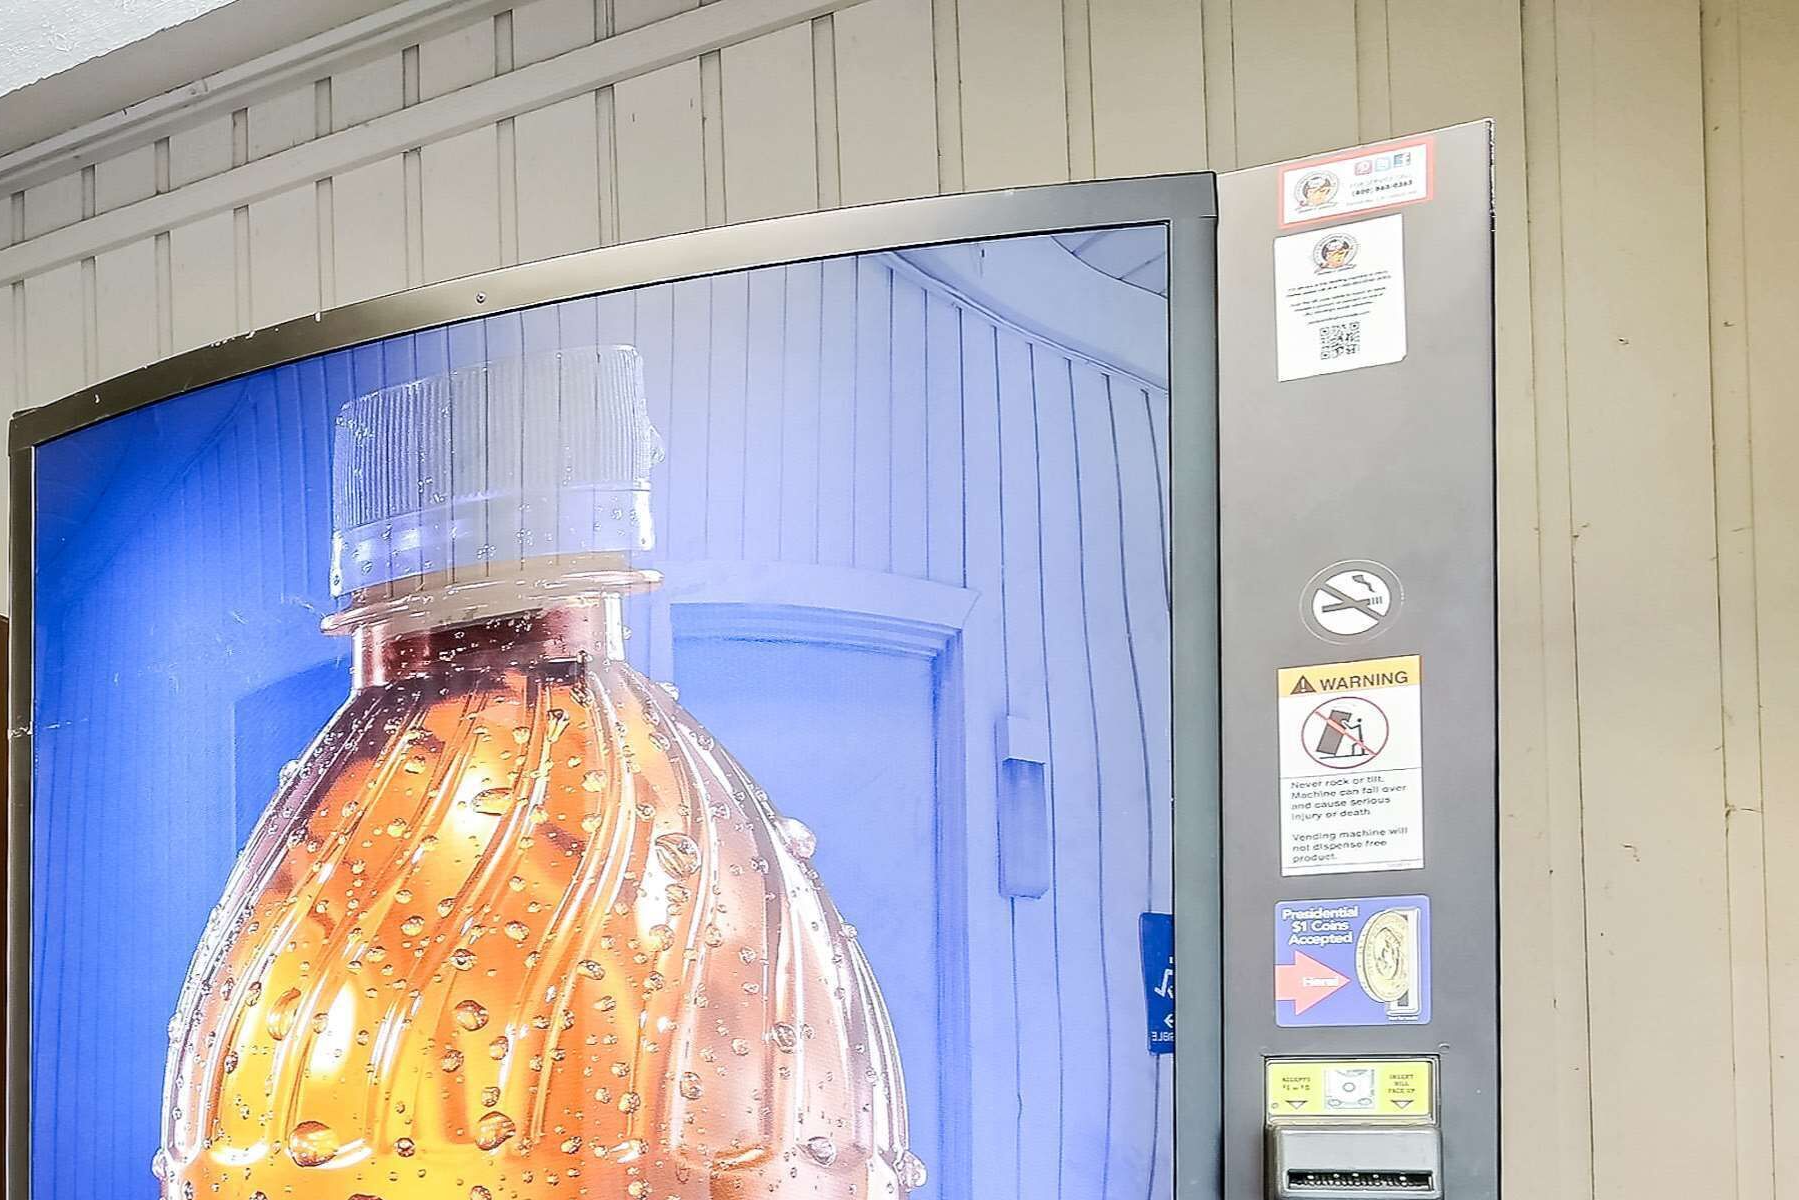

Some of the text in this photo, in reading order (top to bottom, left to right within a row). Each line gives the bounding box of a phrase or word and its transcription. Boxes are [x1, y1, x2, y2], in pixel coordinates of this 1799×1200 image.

[1320, 671, 1408, 691] WARNING
[1290, 781, 1322, 789] Never
[1325, 778, 1349, 786] rock
[1291, 791, 1336, 799] Machine
[1362, 786, 1379, 794] fall
[1381, 785, 1407, 793] over
[1291, 797, 1391, 810] and cause serious
[1292, 832, 1336, 841] Vending
[1339, 830, 1386, 838] machine
[1292, 844, 1310, 852] not
[1312, 841, 1362, 850] dispense
[1282, 906, 1359, 920] Presidential
[1291, 920, 1350, 933] $1 Coins
[1289, 932, 1353, 947] Accepted
